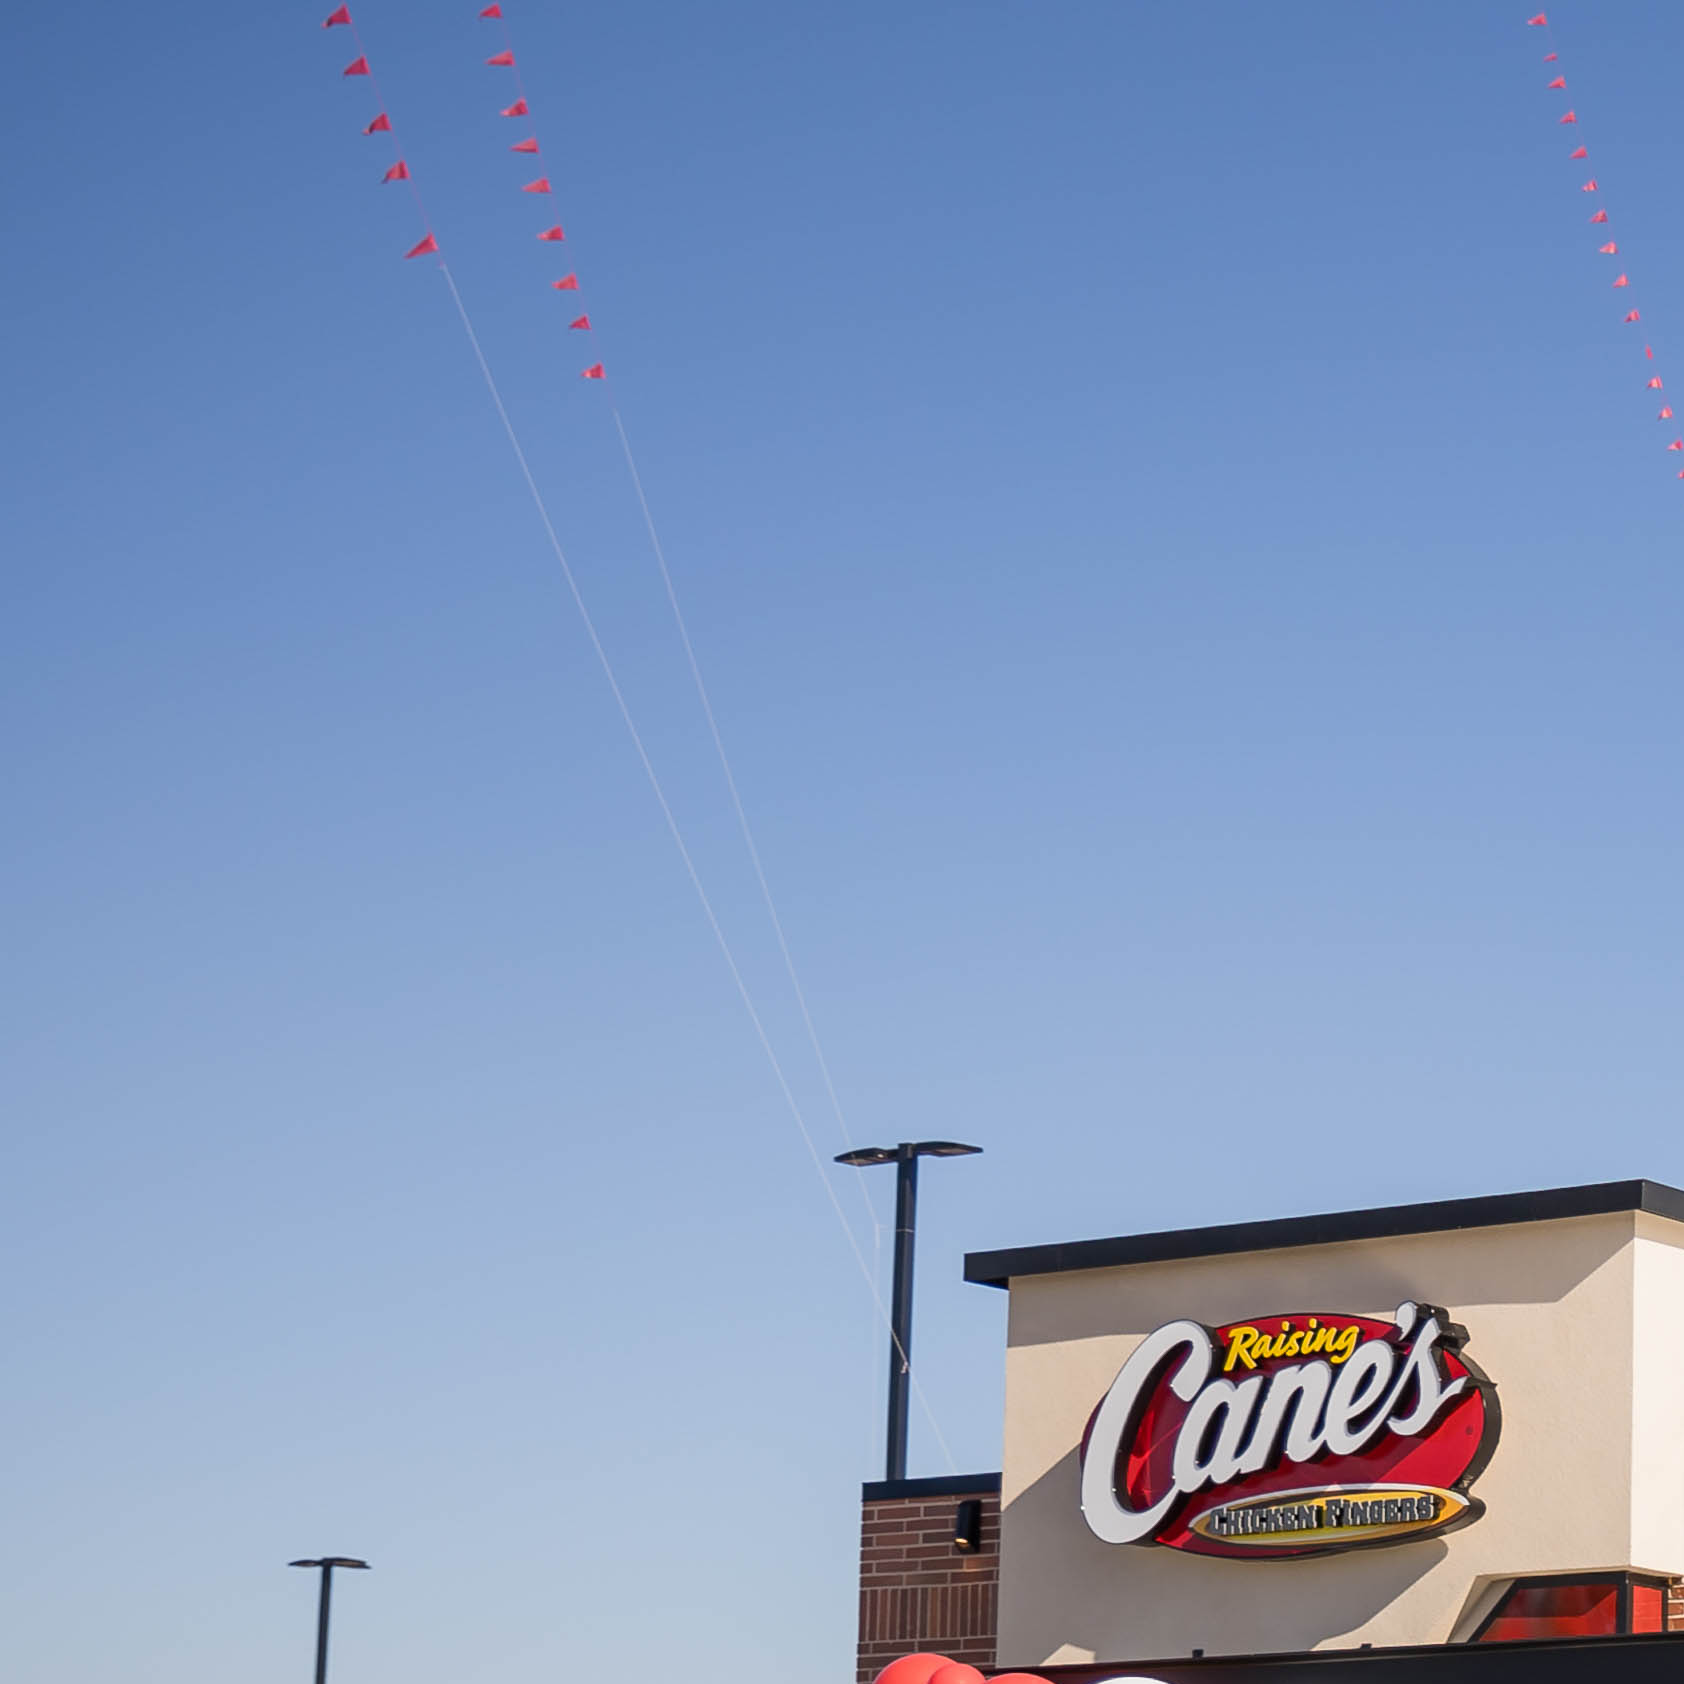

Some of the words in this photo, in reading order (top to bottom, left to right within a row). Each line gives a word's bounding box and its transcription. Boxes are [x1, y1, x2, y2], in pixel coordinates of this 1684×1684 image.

[1223, 1318, 1360, 1372] Raising
[1081, 1300, 1470, 1545] Cane's
[1209, 1504, 1320, 1537] CHICKEN
[1325, 1494, 1442, 1529] FINGERS
